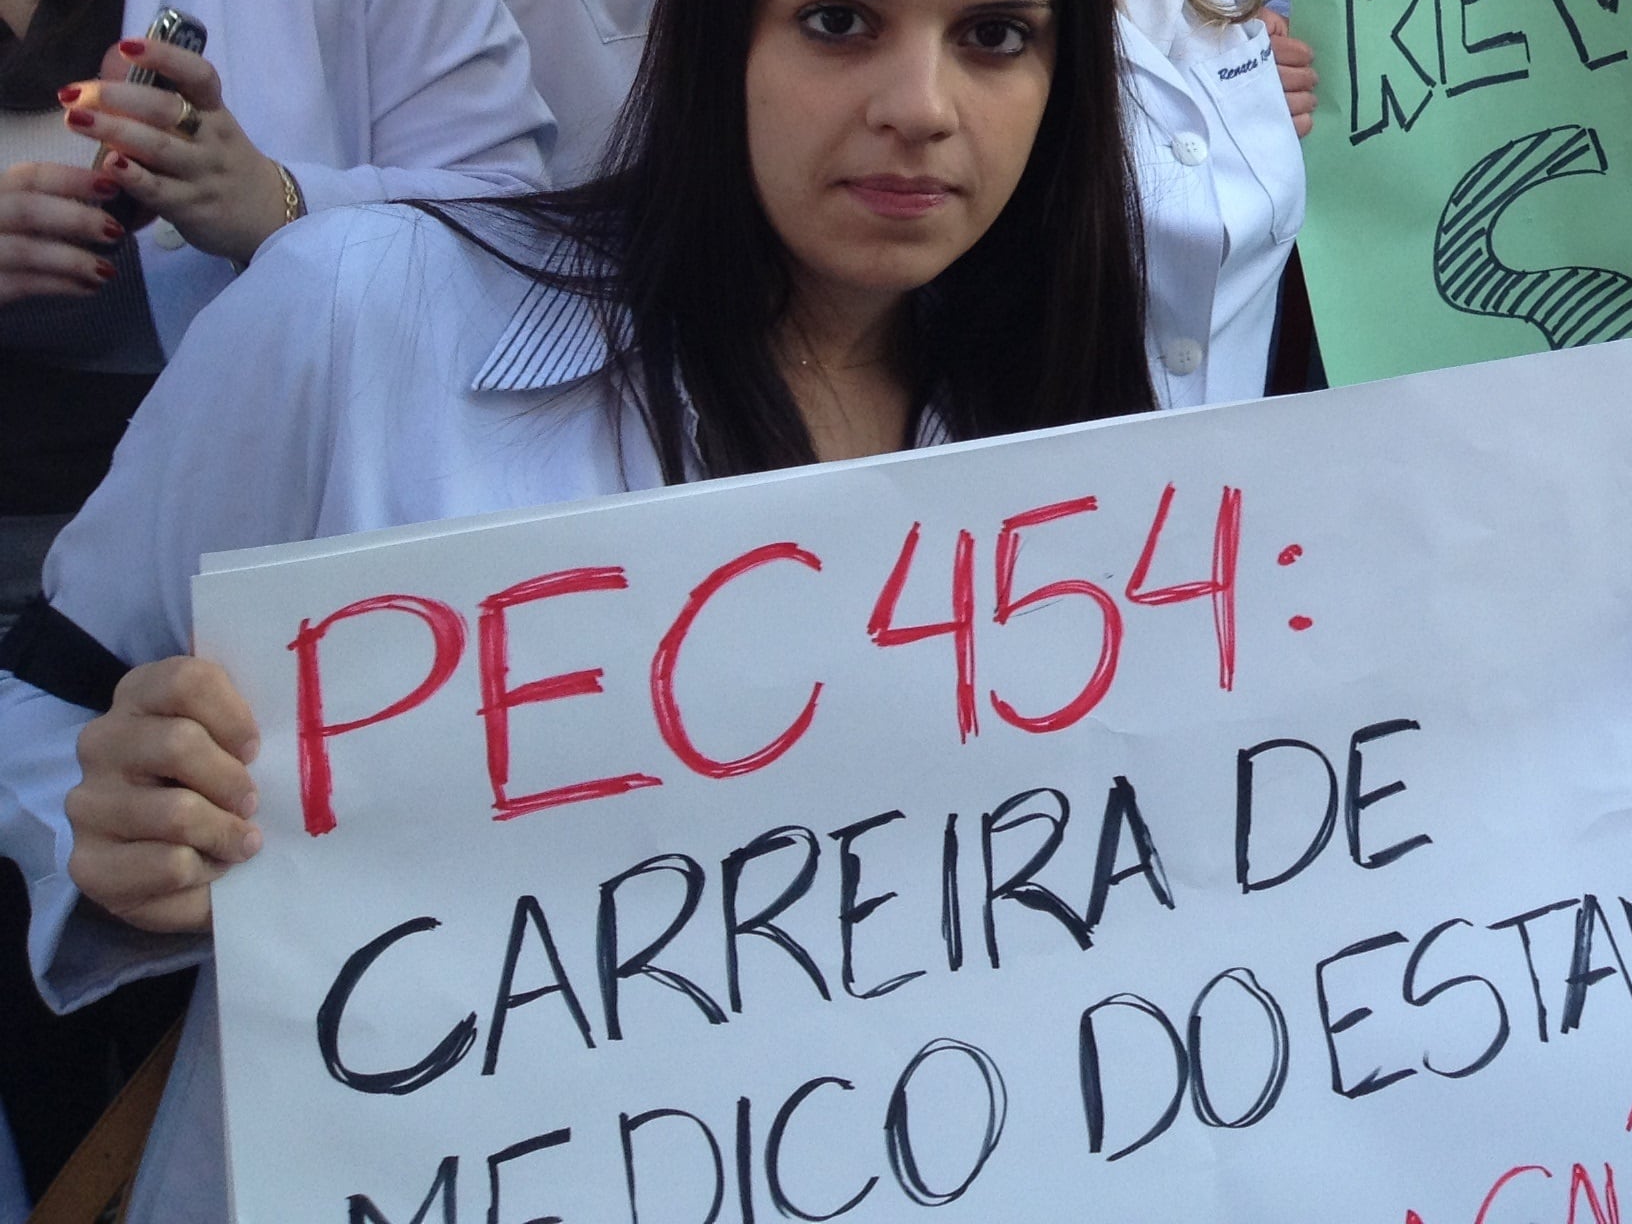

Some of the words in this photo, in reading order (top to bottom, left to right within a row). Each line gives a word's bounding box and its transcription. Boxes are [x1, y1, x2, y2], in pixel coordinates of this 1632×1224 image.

[287, 541, 822, 837] PEC
[866, 480, 1313, 744] 454:
[316, 775, 1176, 1096] CARREIRA
[1235, 718, 1433, 894] DE
[1079, 966, 1290, 1162] DO
